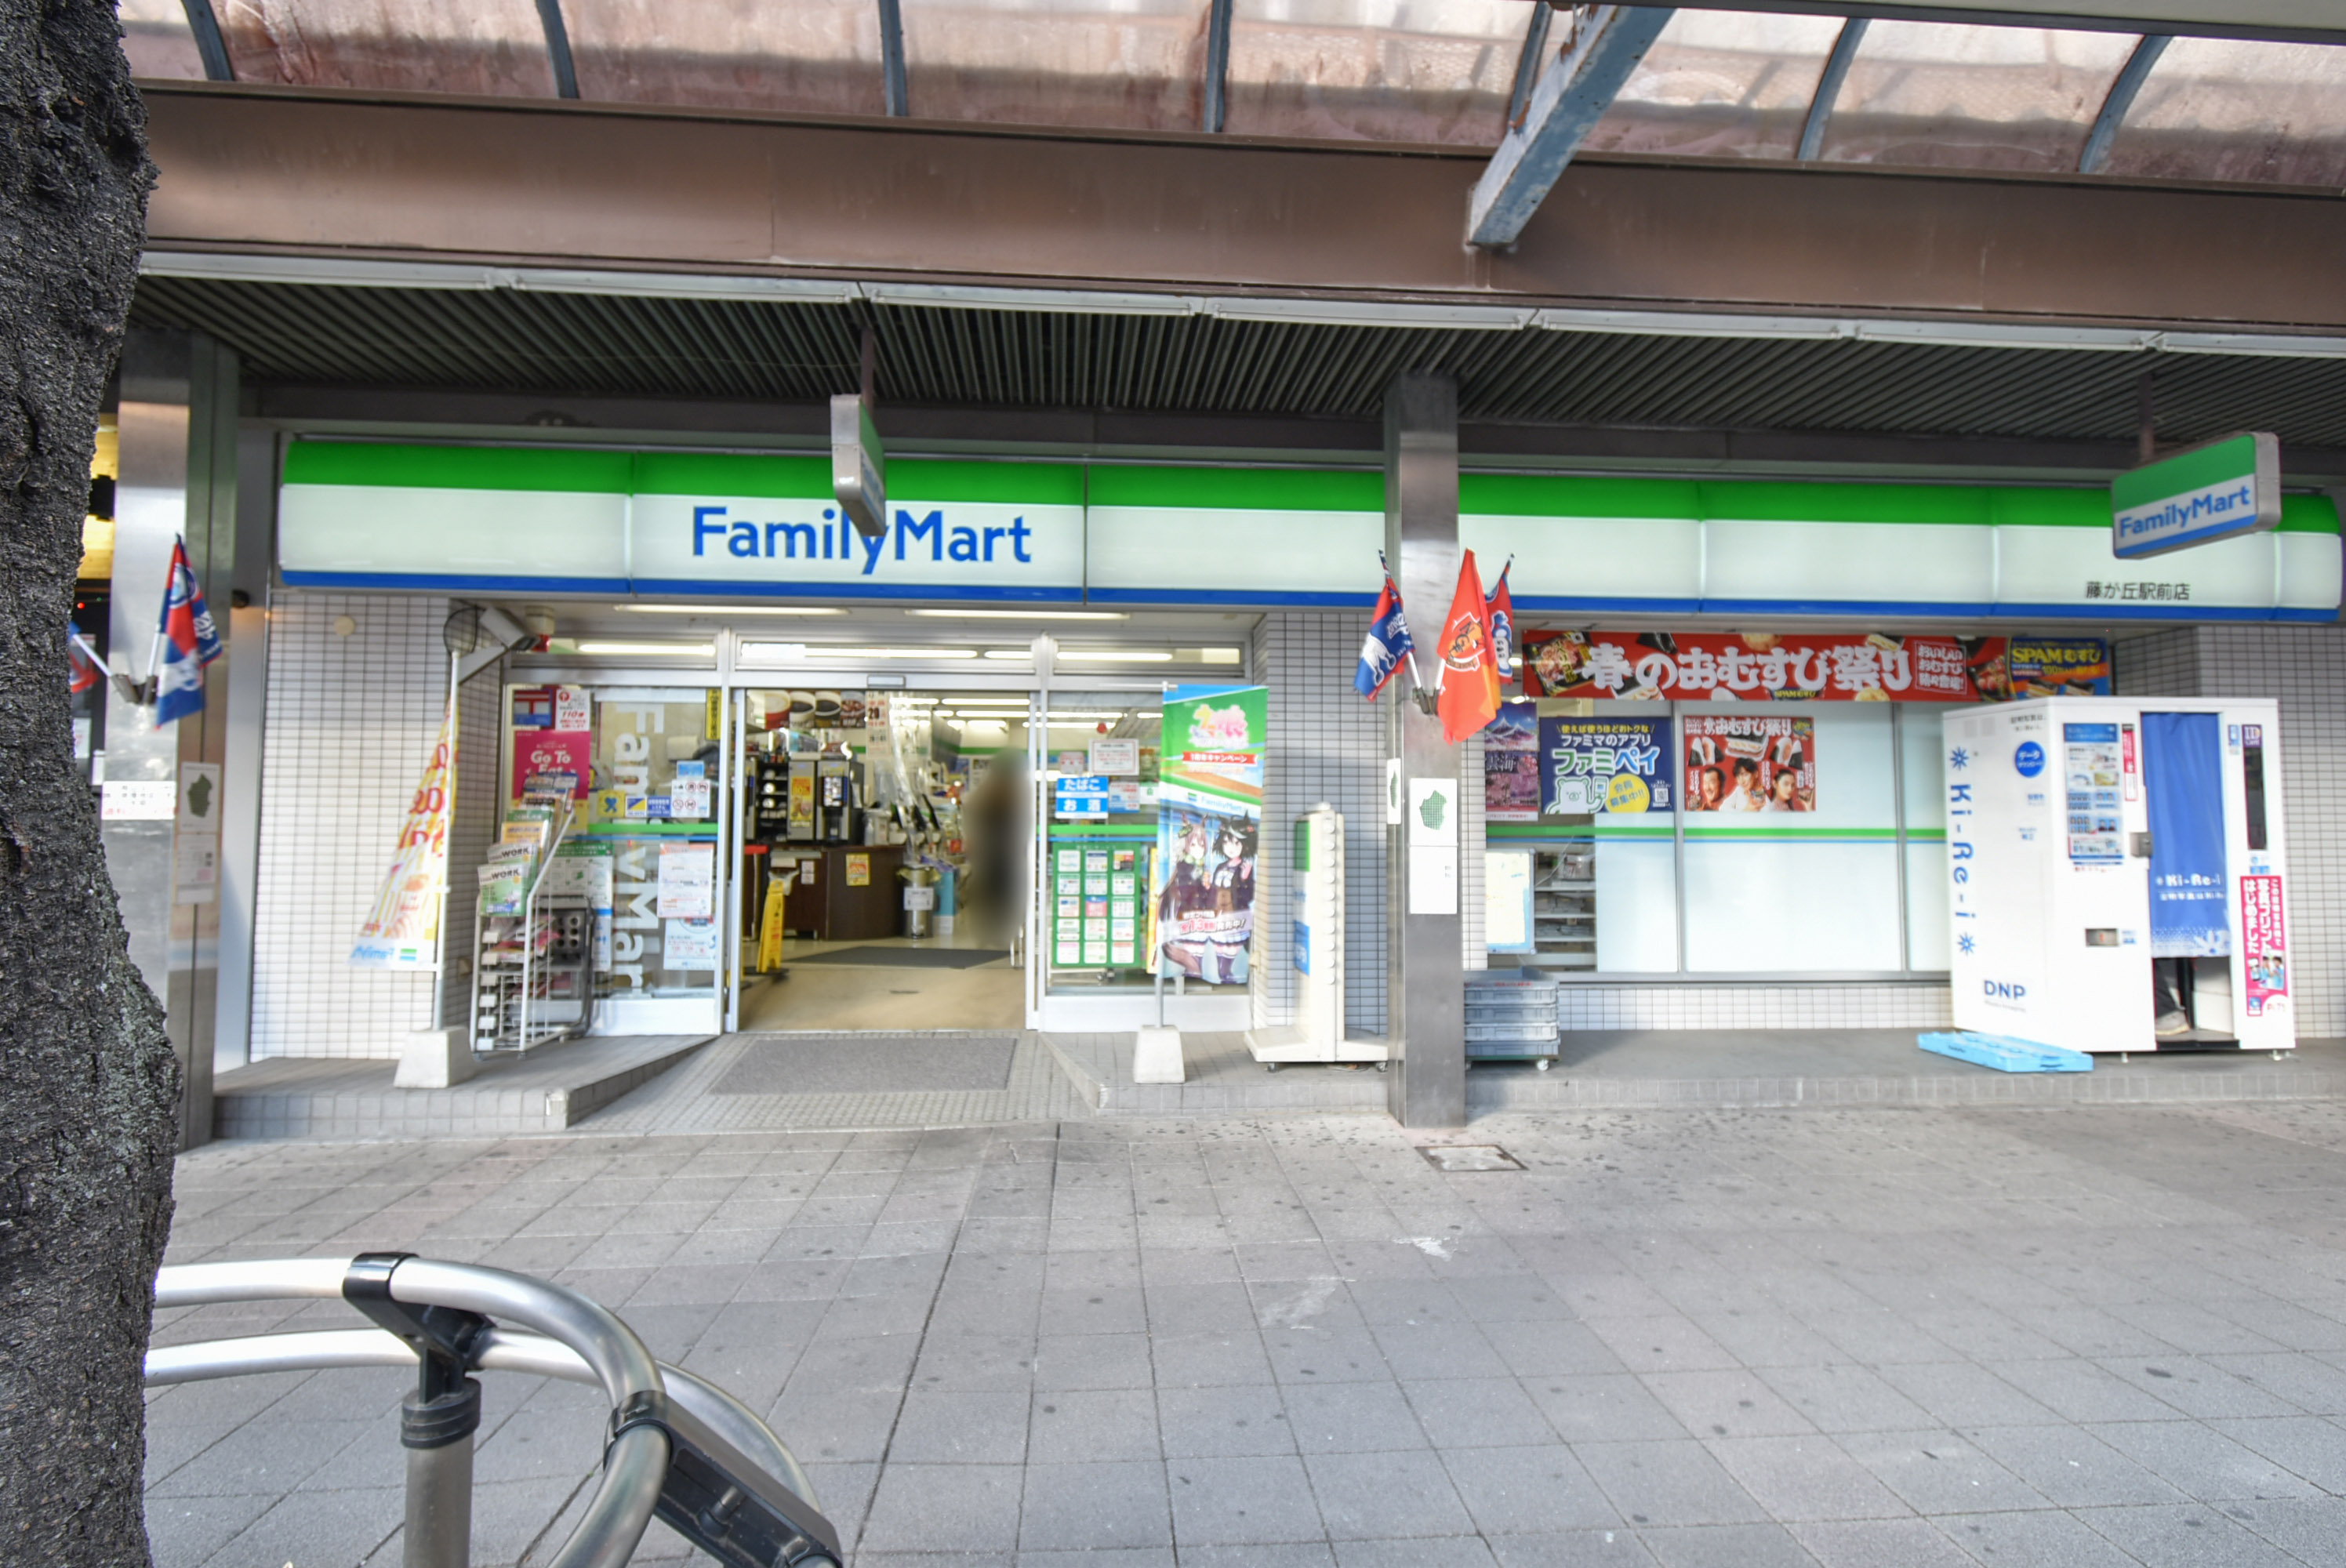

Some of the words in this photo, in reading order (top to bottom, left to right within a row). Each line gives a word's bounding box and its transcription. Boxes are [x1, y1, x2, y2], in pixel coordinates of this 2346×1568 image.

[2120, 486, 2250, 538] FamilyMart
[693, 506, 1031, 574] FamilyMart
[2086, 582, 2190, 601] 藤が丘駅前店
[1582, 642, 1913, 691] 春のおむすび祭り
[1560, 734, 1651, 747] ファミマのアプリ
[530, 750, 552, 764] Go
[554, 750, 572, 764] To
[1553, 746, 1660, 775] ファミペイ
[2017, 750, 2041, 760] データ
[1064, 779, 1101, 791] たばこ
[1949, 784, 1977, 919] Ki-Re-i
[2242, 879, 2260, 953] はじめました
[1983, 979, 2026, 1000] DNP
